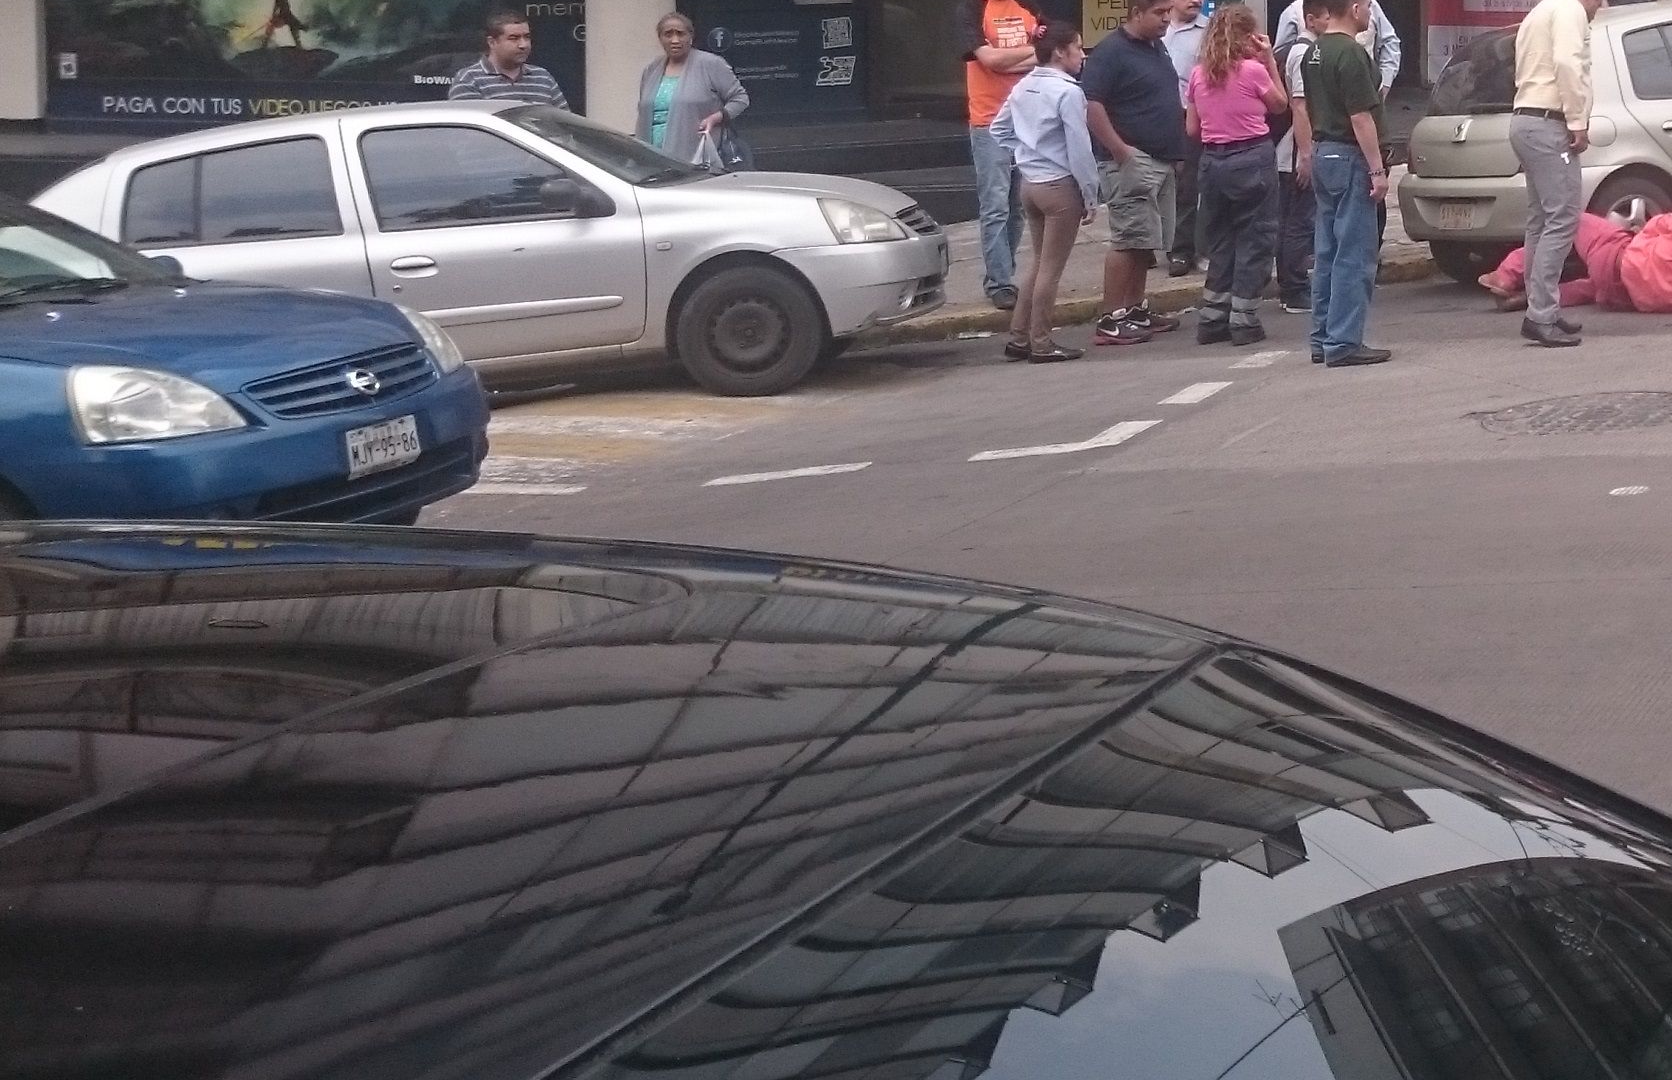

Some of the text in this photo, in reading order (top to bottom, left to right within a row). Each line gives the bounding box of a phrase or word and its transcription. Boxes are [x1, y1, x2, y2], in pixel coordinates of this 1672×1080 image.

[102, 96, 157, 113] PAGA
[162, 97, 205, 114] CON
[211, 97, 242, 115] TUS
